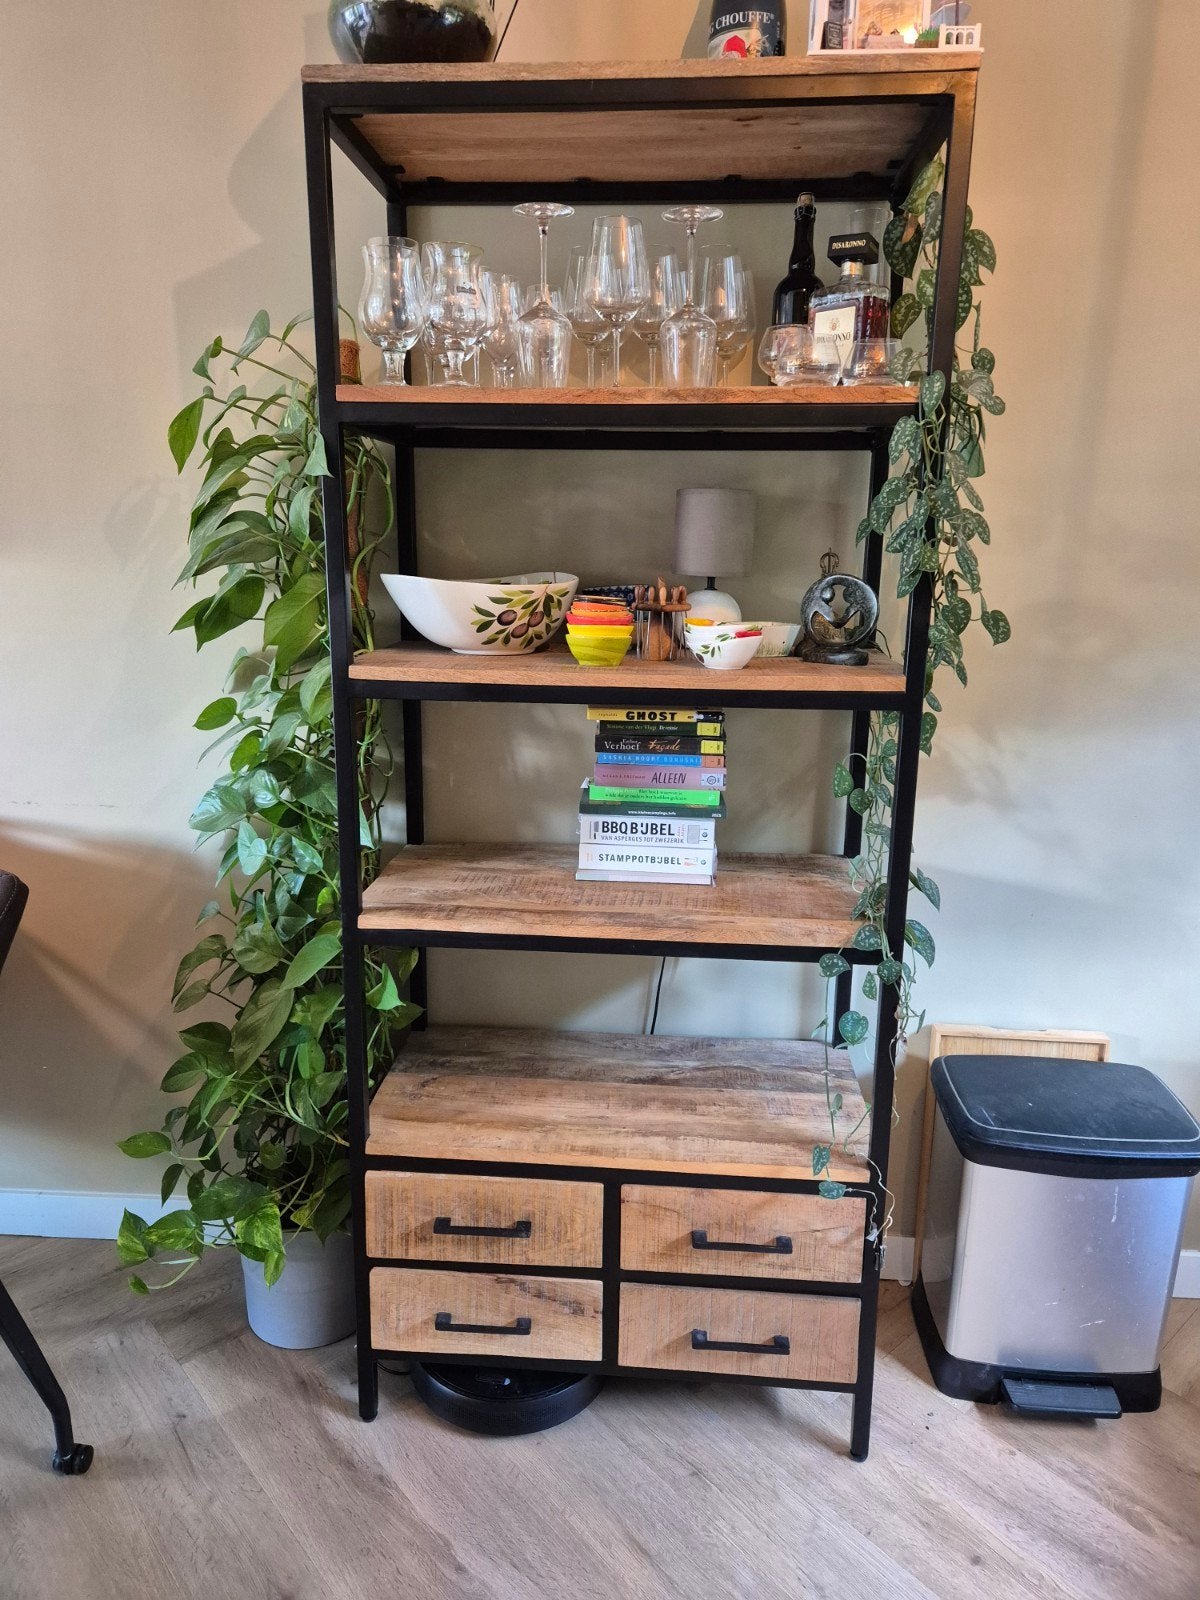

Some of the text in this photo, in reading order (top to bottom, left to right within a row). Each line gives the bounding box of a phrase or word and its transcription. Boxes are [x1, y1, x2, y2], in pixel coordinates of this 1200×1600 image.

[715, 10, 771, 30] CHOUFFE
[831, 239, 866, 250] DISARONNO
[816, 332, 851, 345] DISAONNO
[625, 711, 678, 721] GHOST
[604, 740, 641, 751] Verhoef
[651, 772, 686, 784] ALLEEN
[614, 835, 643, 843] ASPERGES
